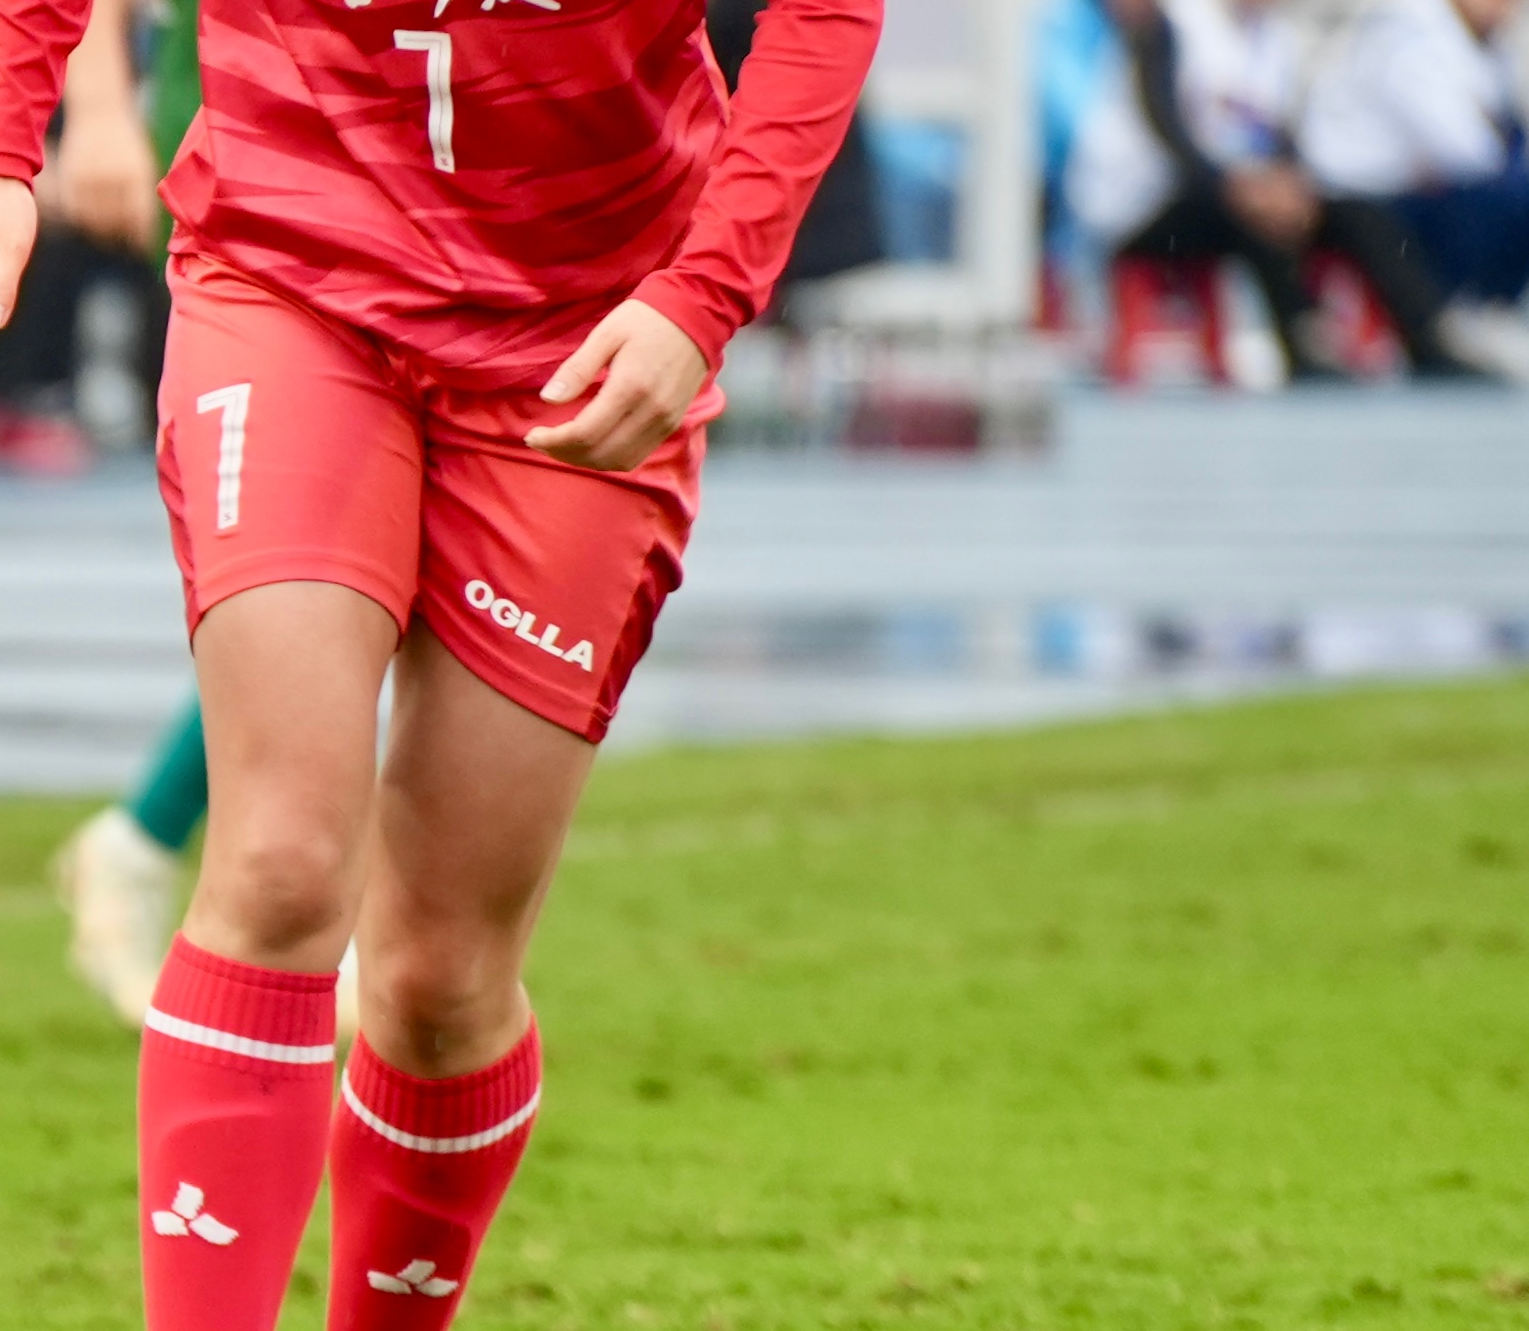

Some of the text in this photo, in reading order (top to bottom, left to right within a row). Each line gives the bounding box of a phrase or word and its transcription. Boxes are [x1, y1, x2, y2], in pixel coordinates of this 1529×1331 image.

[393, 29, 455, 174] 7
[196, 382, 251, 530] 7
[464, 578, 596, 673] OGLLA
